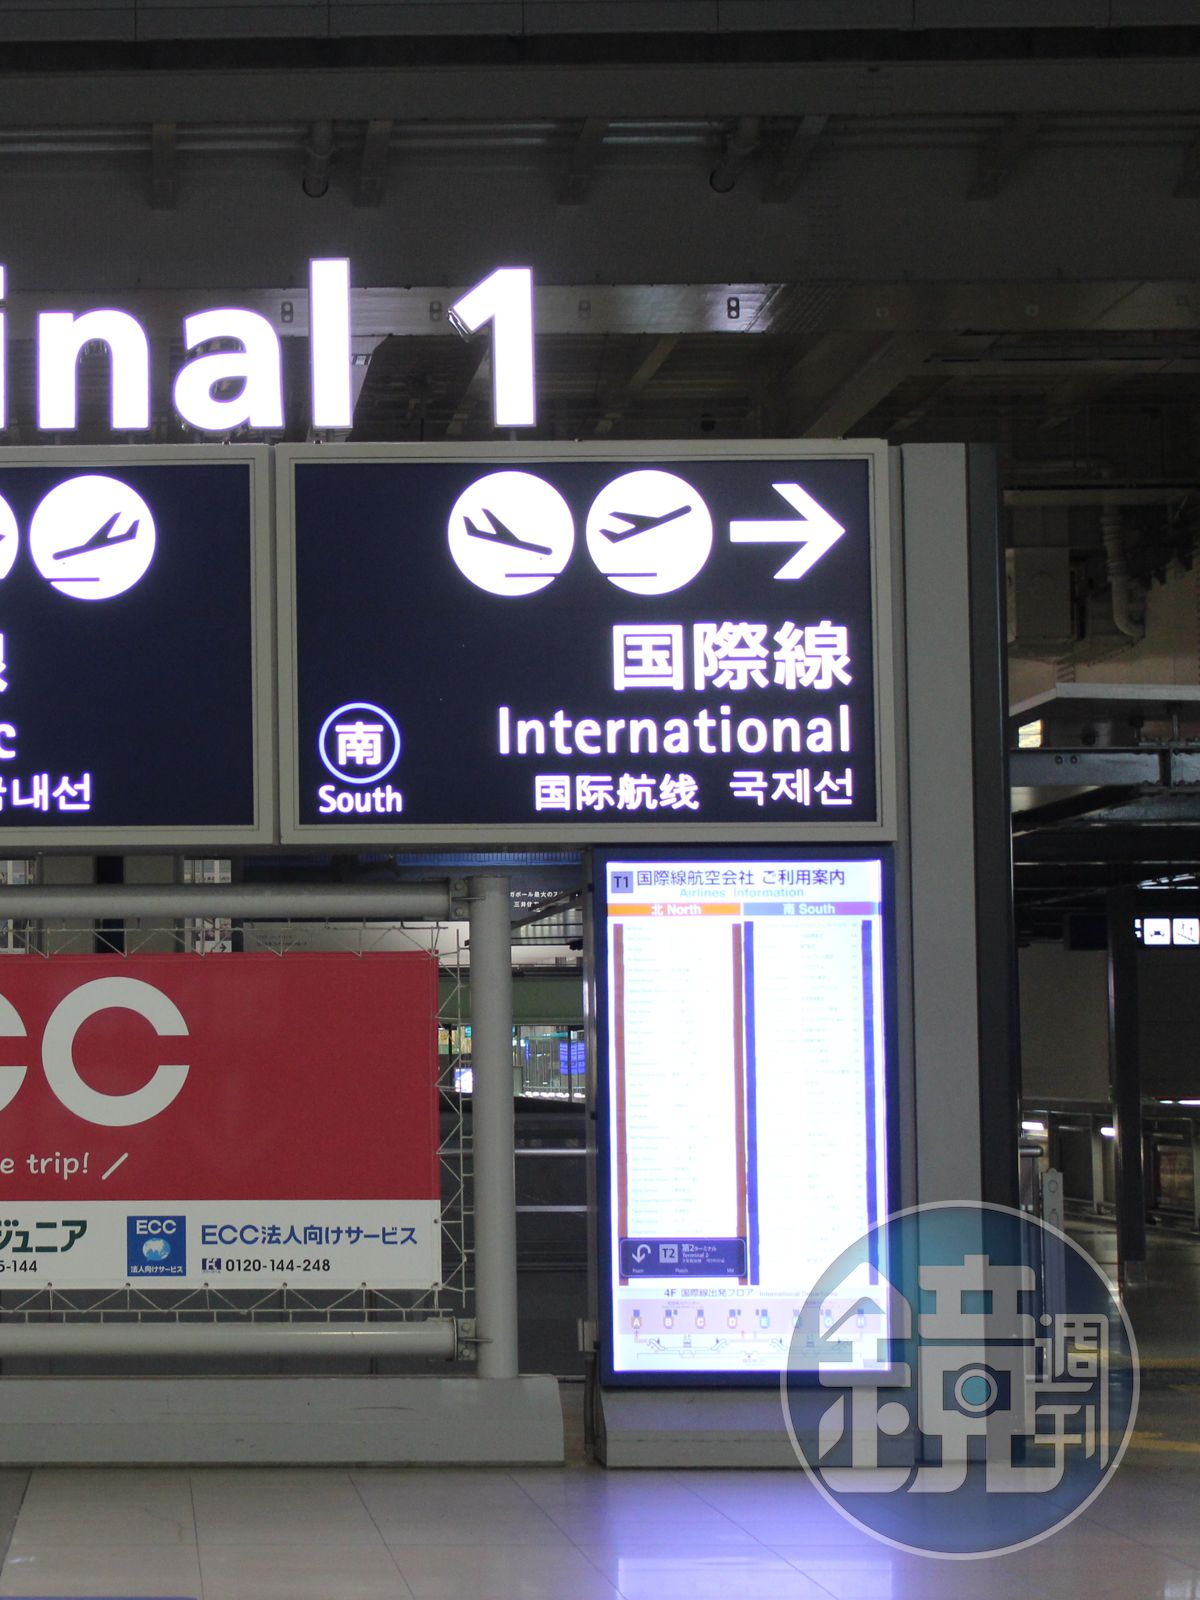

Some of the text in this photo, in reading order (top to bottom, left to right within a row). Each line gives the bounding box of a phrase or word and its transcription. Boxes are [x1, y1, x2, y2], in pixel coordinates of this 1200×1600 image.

[447, 266, 536, 427] 1
[612, 620, 853, 692] 国際線
[498, 704, 851, 756] International
[334, 720, 385, 767] 南
[534, 767, 854, 812] 国际航线 국제선
[317, 783, 403, 814] South
[613, 875, 630, 889] T1
[636, 869, 846, 887] 国際線航空会社 ご利用案内
[679, 887, 805, 899] Airlines Information
[650, 904, 702, 916] 北 North
[798, 903, 836, 915] South
[26, 1151, 91, 1181] trip!
[135, 1219, 178, 1235] ECC
[201, 1223, 419, 1246] ECC法人向けサービス
[662, 1247, 676, 1259] T2
[130, 1265, 184, 1274] 法人向けサービス
[225, 1258, 332, 1273] 0120-144-248
[663, 1288, 677, 1298] 4F
